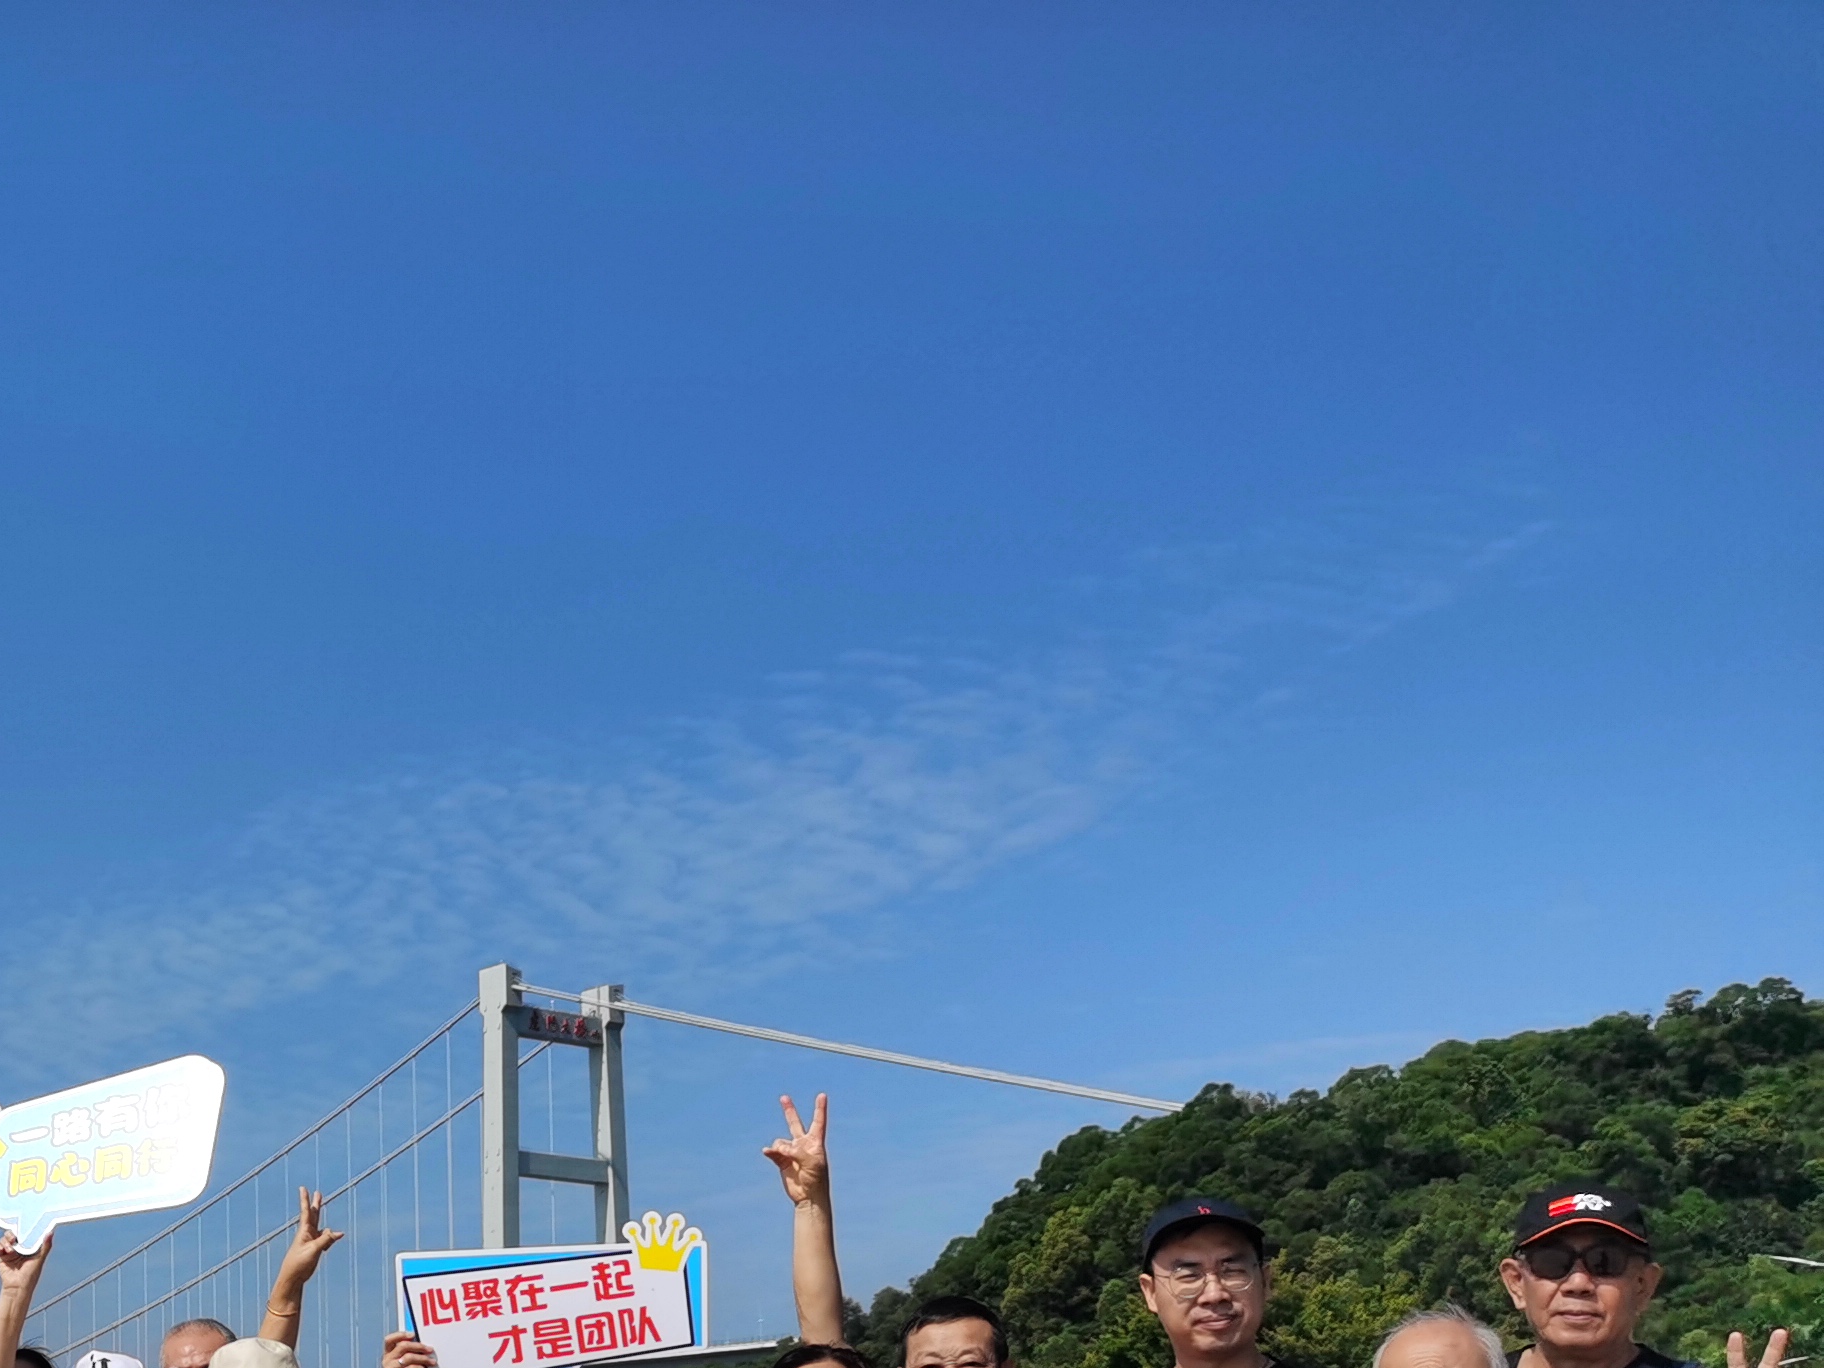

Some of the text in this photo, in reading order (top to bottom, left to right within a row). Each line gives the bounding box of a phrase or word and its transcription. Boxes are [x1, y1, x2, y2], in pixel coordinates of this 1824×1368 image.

[7, 1136, 178, 1197] 同心同行
[419, 1259, 636, 1327] 心聚在一起
[487, 1305, 662, 1365] 才是团队
